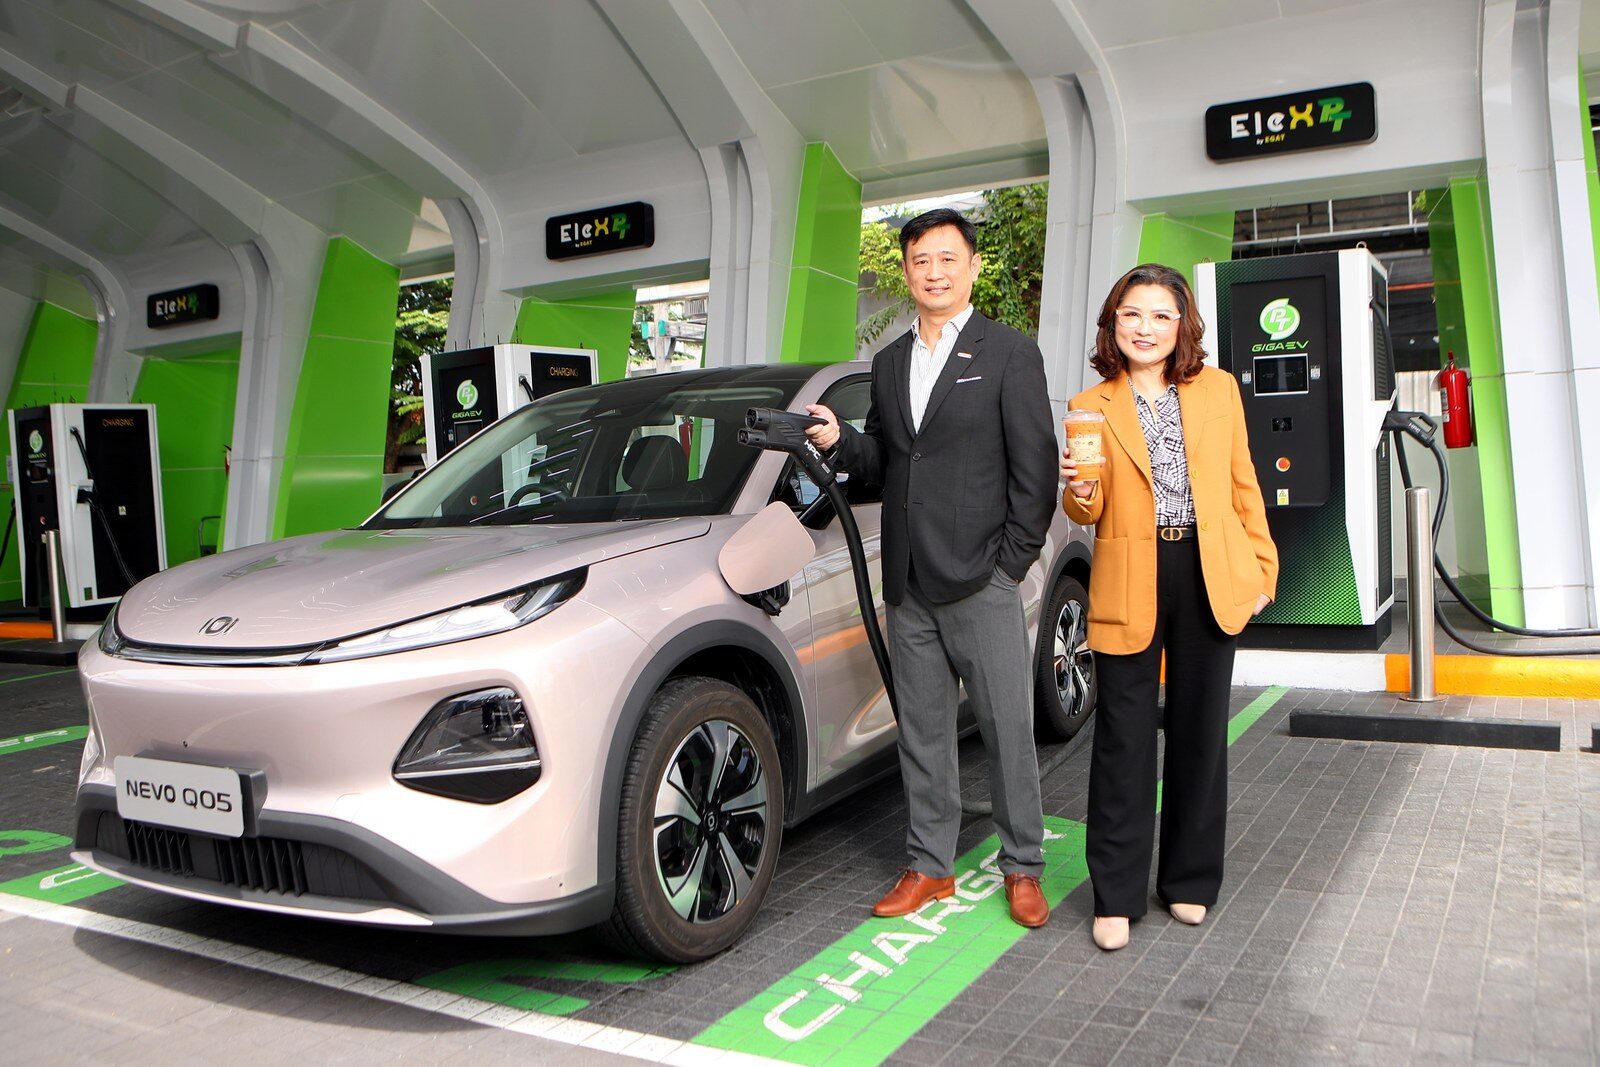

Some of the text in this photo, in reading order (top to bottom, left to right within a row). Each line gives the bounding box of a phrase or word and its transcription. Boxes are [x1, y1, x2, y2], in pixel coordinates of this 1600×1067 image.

[1264, 133, 1286, 144] EGAT
[126, 779, 232, 812] NEVO Q05
